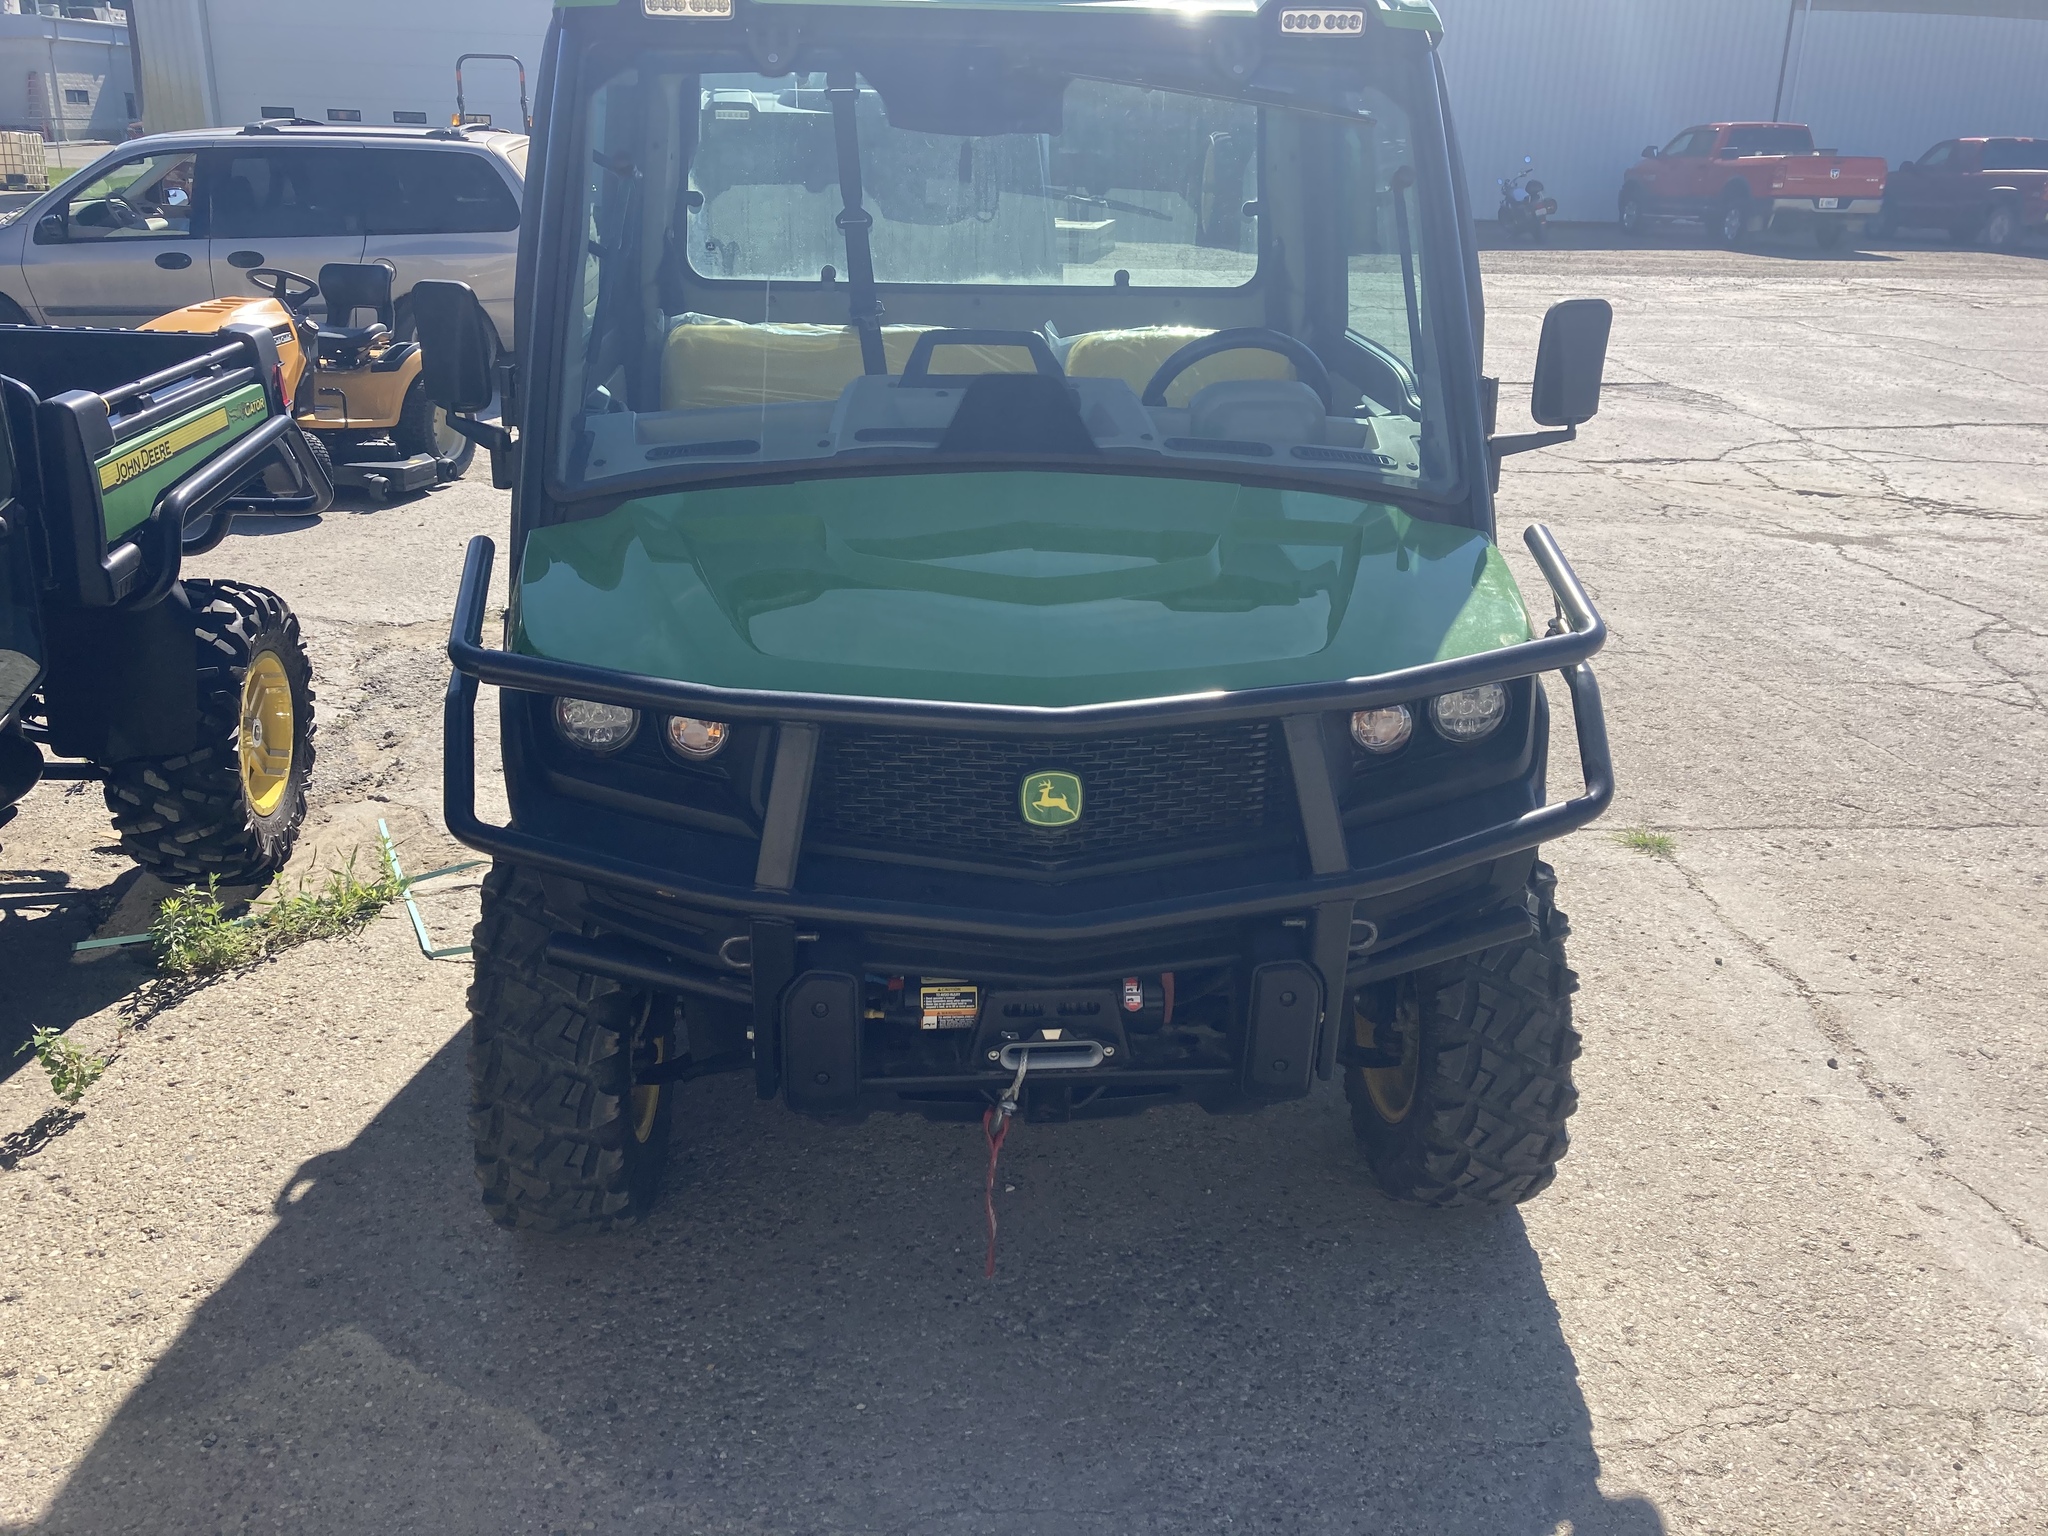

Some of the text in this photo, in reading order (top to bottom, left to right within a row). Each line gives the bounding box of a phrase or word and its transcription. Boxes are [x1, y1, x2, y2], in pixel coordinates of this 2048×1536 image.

[244, 397, 265, 417] GATOR
[115, 440, 172, 483] JOHN DEERE
